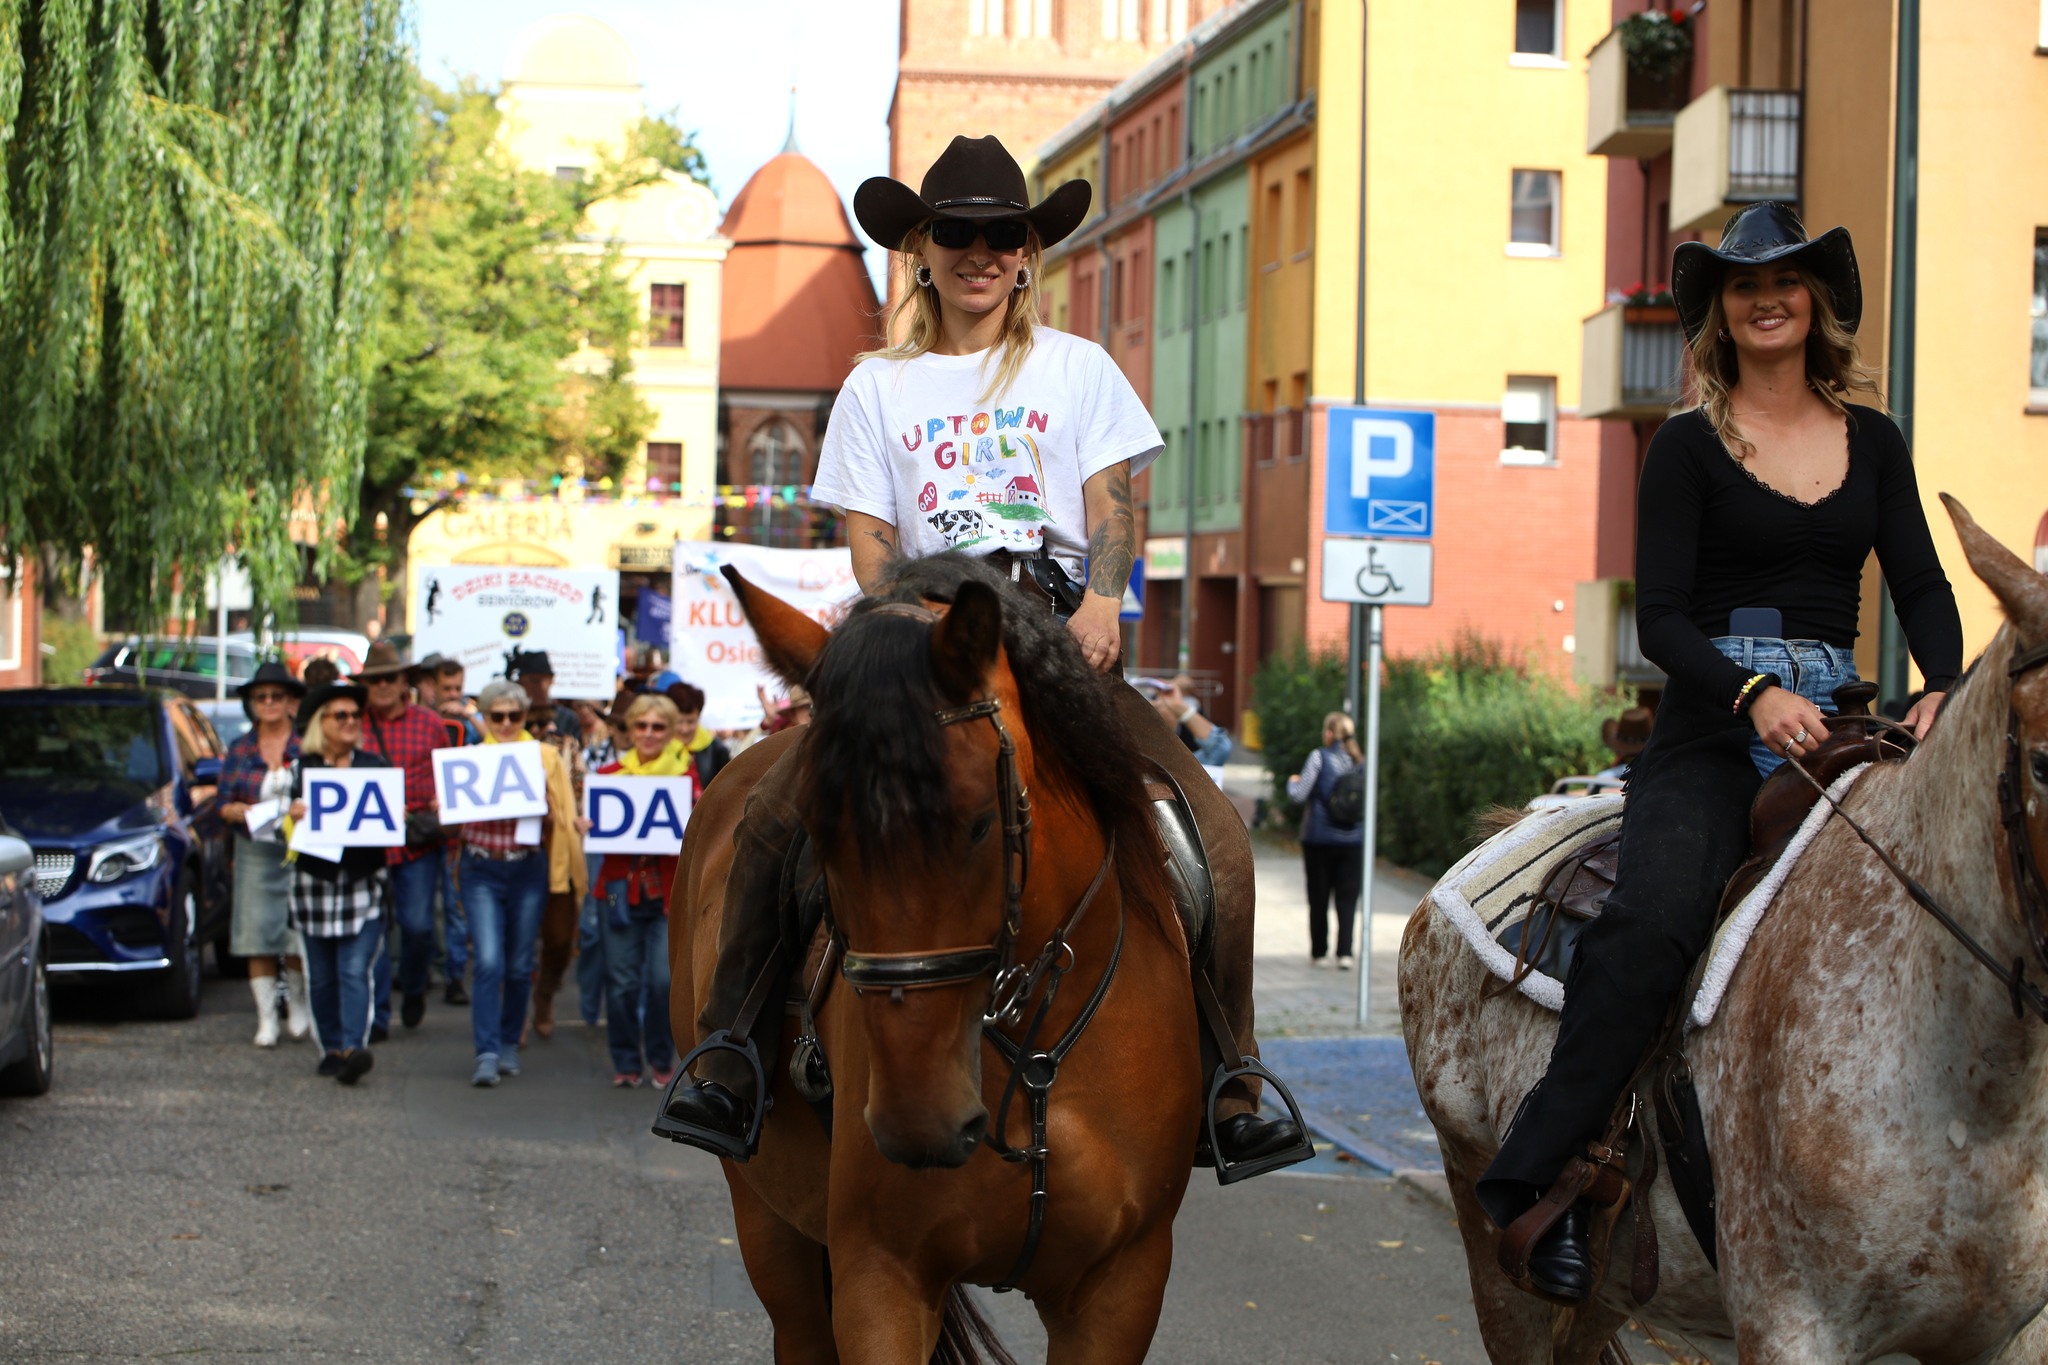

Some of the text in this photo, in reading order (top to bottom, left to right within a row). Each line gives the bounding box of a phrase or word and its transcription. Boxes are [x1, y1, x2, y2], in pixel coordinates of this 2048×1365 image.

[901, 406, 1049, 452] UPTOWN
[934, 434, 1017, 470] GIRL
[1350, 418, 1414, 499] P
[689, 600, 745, 628] KLU
[706, 640, 759, 664] Osie
[310, 779, 398, 832] PA
[441, 754, 538, 810] RA
[589, 787, 684, 839] DA
